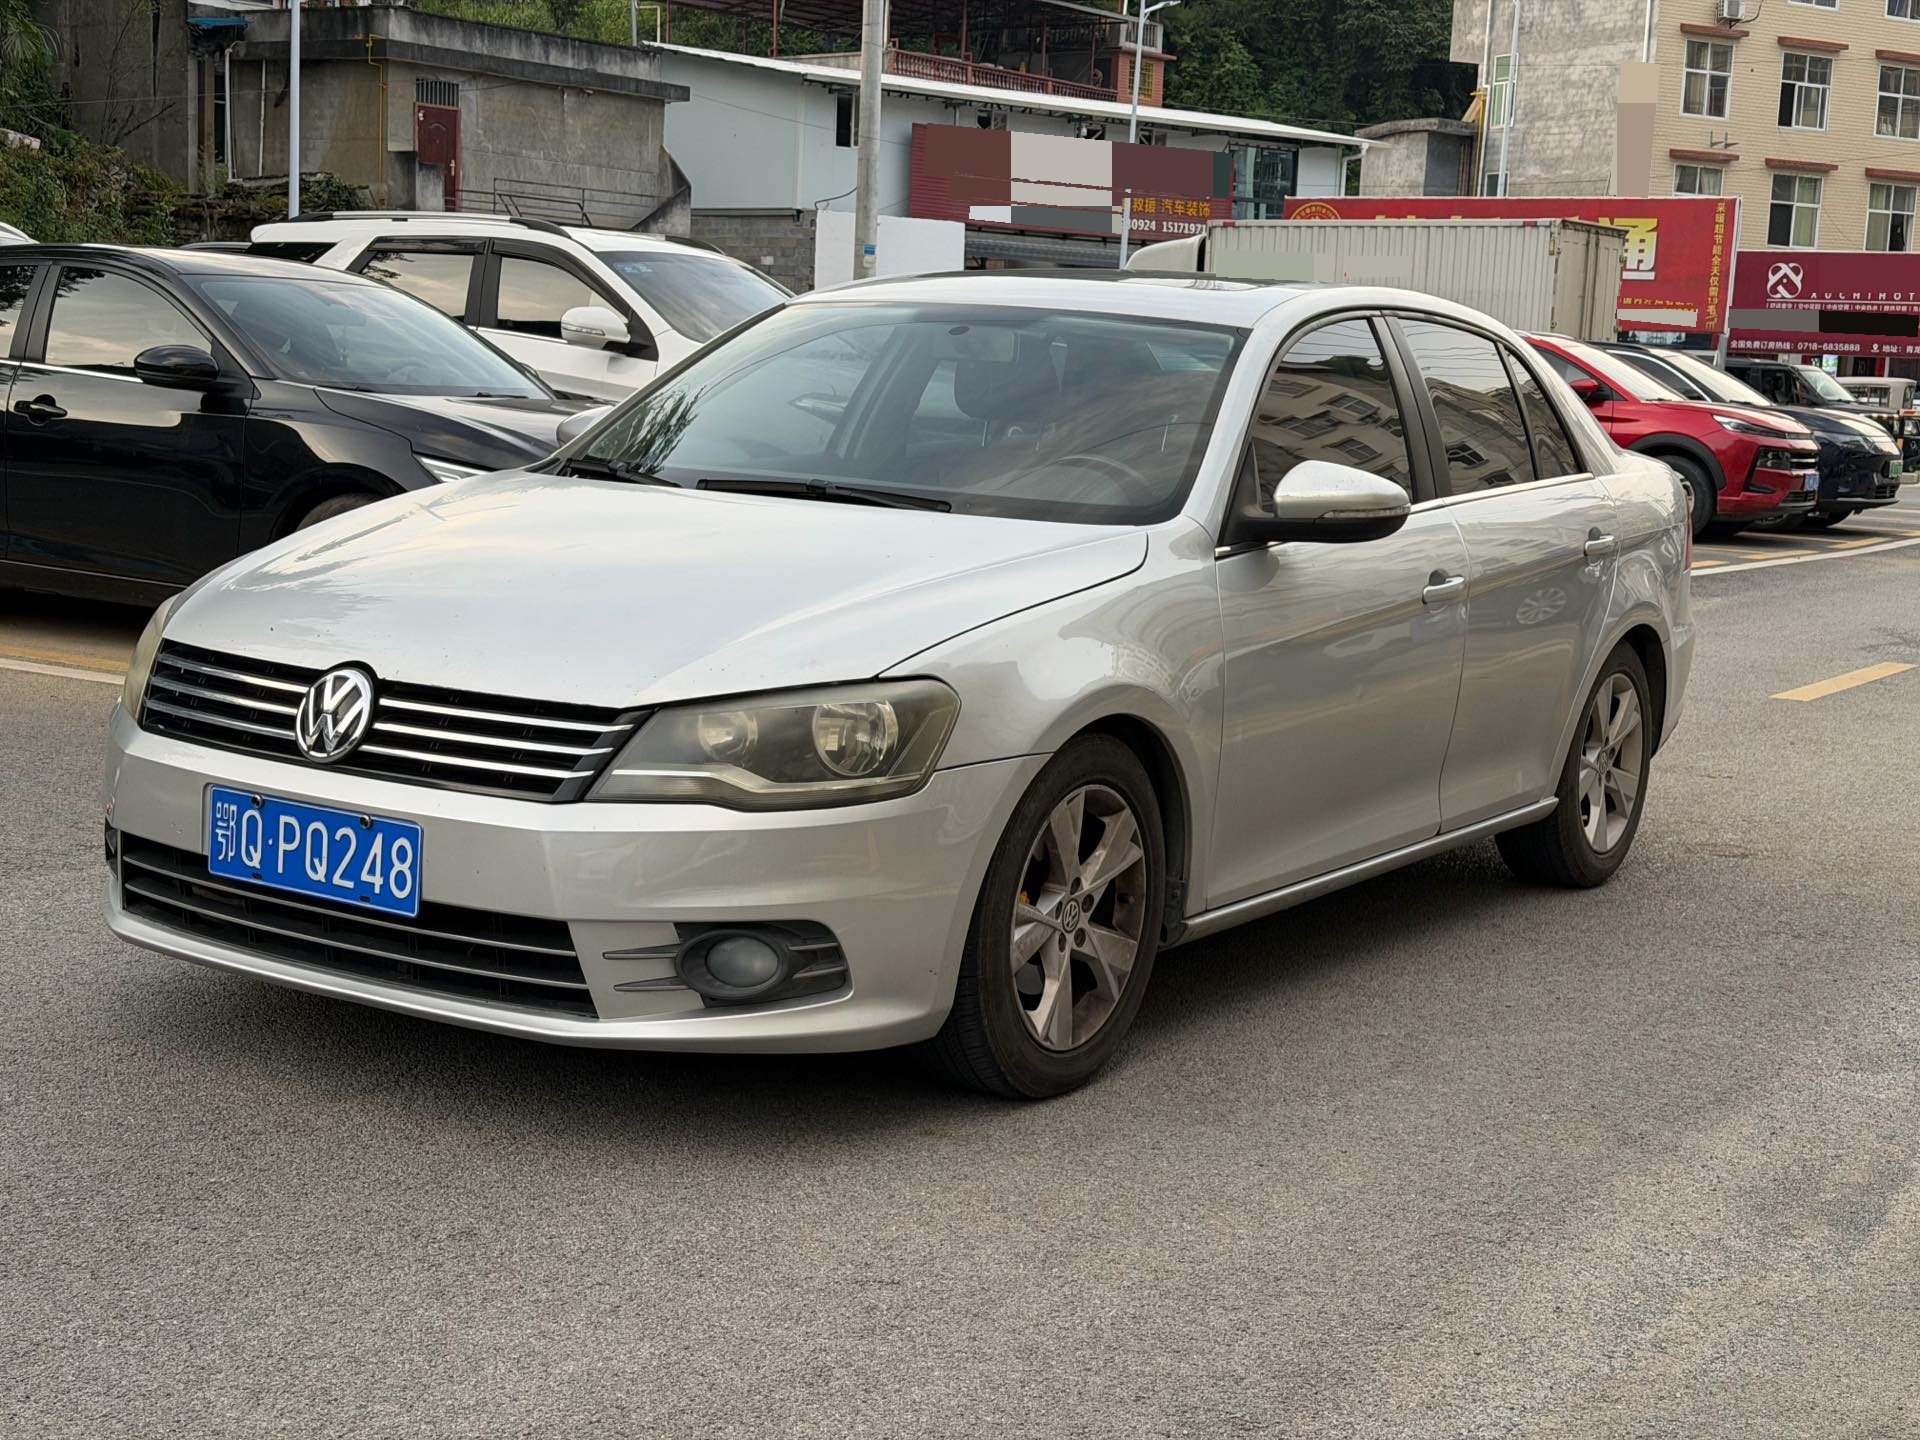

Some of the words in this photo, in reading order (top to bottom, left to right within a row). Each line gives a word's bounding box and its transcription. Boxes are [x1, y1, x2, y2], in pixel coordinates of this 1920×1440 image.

[1162, 199, 1210, 217] 汽车装饰
[1127, 219, 1156, 231] 0924
[215, 800, 413, 899] 鄂Q·PQ248
